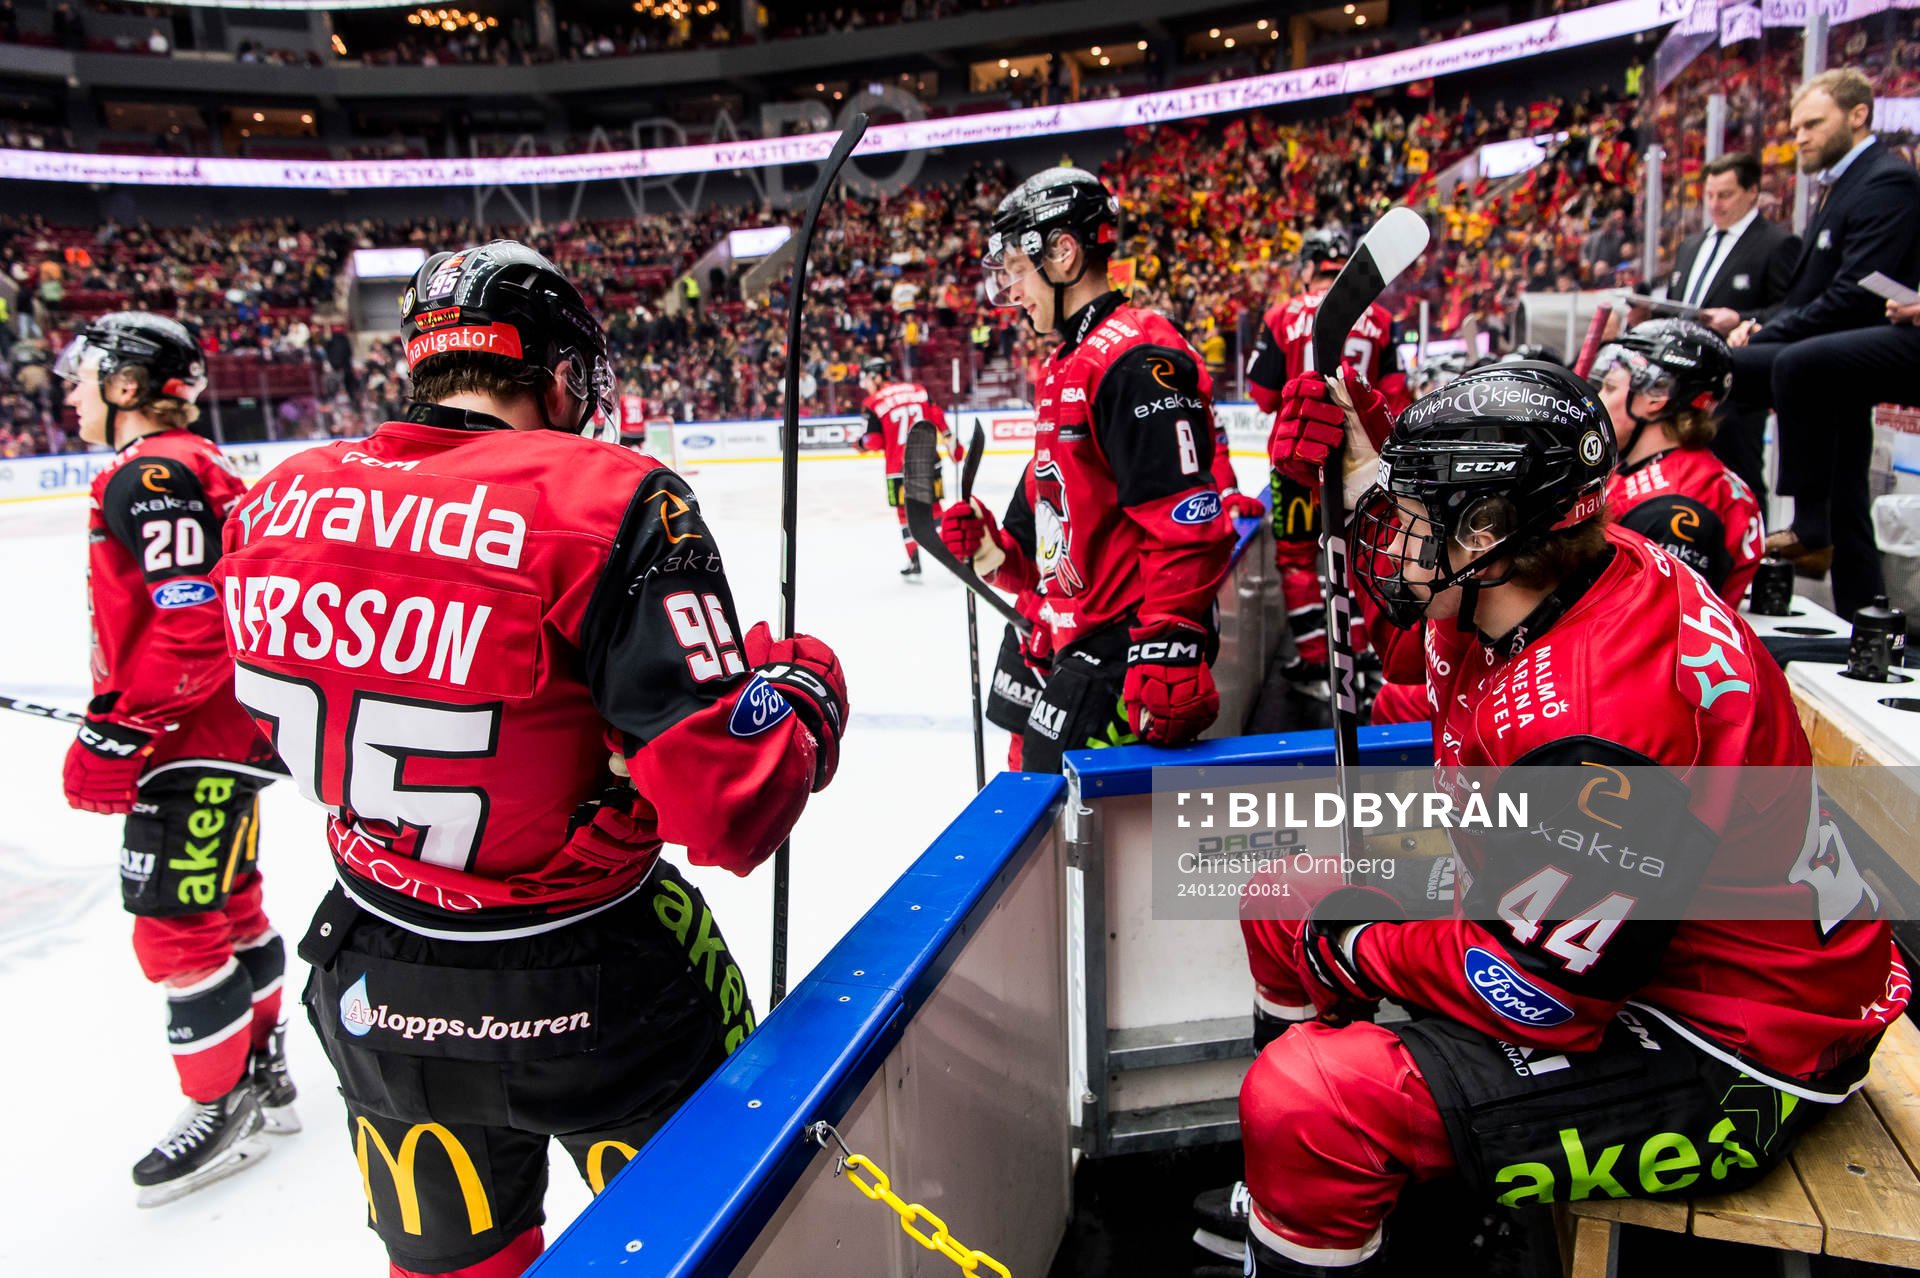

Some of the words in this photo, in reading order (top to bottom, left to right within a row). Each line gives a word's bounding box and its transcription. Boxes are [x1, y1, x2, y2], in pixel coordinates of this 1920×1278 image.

[409, 327, 499, 366] navigator
[1408, 396, 1454, 425] hylen
[1490, 387, 1588, 424] kjellander
[1525, 407, 1551, 418] VVS
[1175, 420, 1199, 475] 8
[1455, 460, 1517, 473] CCM
[263, 475, 526, 569] bravida
[1180, 494, 1221, 522] Ford
[143, 517, 205, 572] 20
[156, 583, 212, 606] Ford
[1448, 567, 1476, 587] CCM
[225, 575, 492, 686] PERSSON
[1326, 535, 1357, 714] CCM
[1127, 642, 1198, 663] CCM
[168, 776, 236, 905] akea
[1530, 820, 1666, 879] xakta
[1497, 864, 1639, 976] 44
[1468, 955, 1563, 1024] Ford
